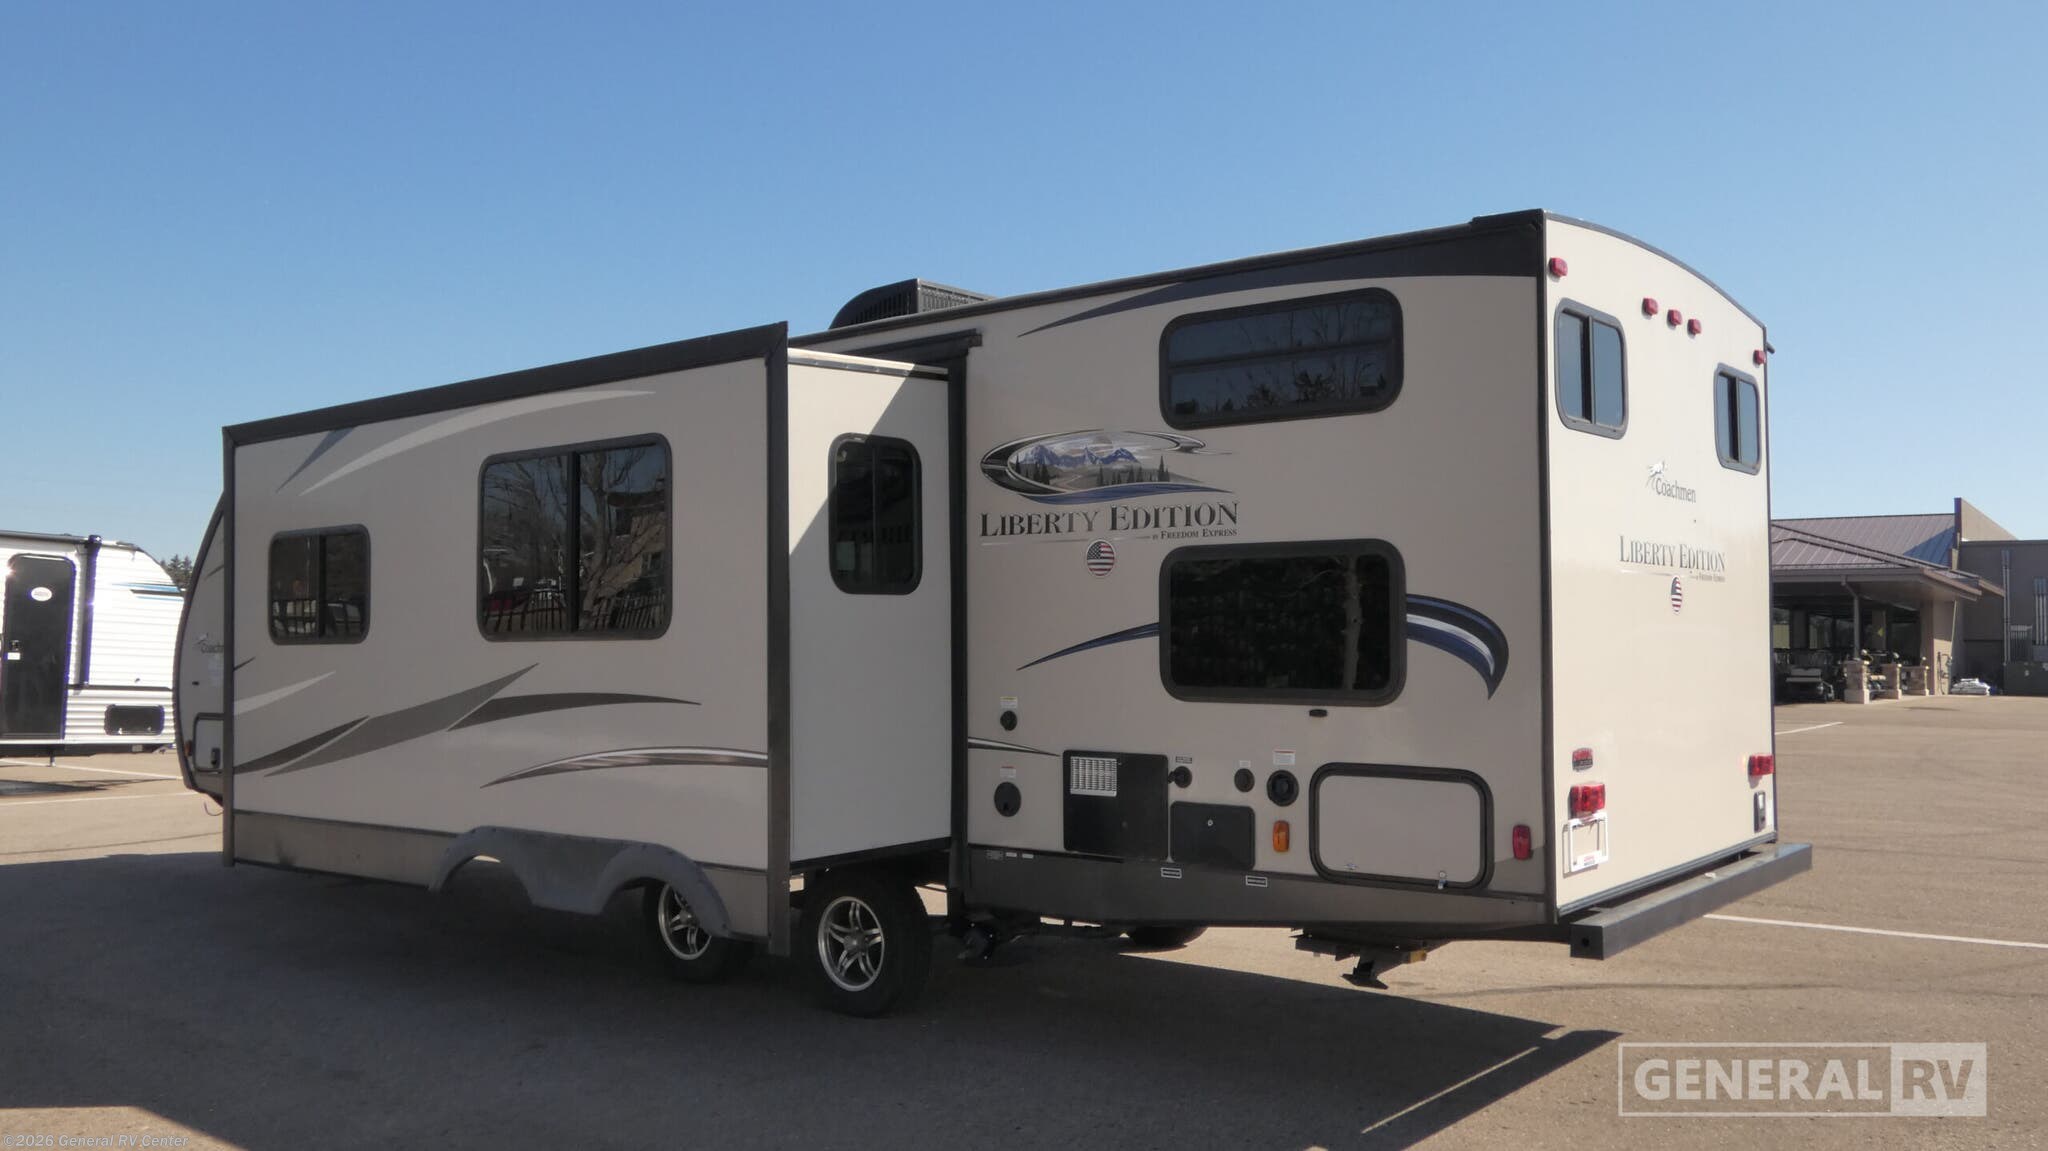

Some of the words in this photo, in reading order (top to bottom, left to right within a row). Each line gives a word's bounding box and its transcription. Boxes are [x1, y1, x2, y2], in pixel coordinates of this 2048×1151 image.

[1655, 478, 1697, 503] Coachmen
[980, 511, 1098, 537] LIBERTY
[1109, 501, 1240, 531] EDITION
[1161, 530, 1200, 540] FREEDOM
[1202, 528, 1238, 538] EXPRESS
[1619, 535, 1676, 567] LIBERTY
[1679, 543, 1726, 571] EDITION
